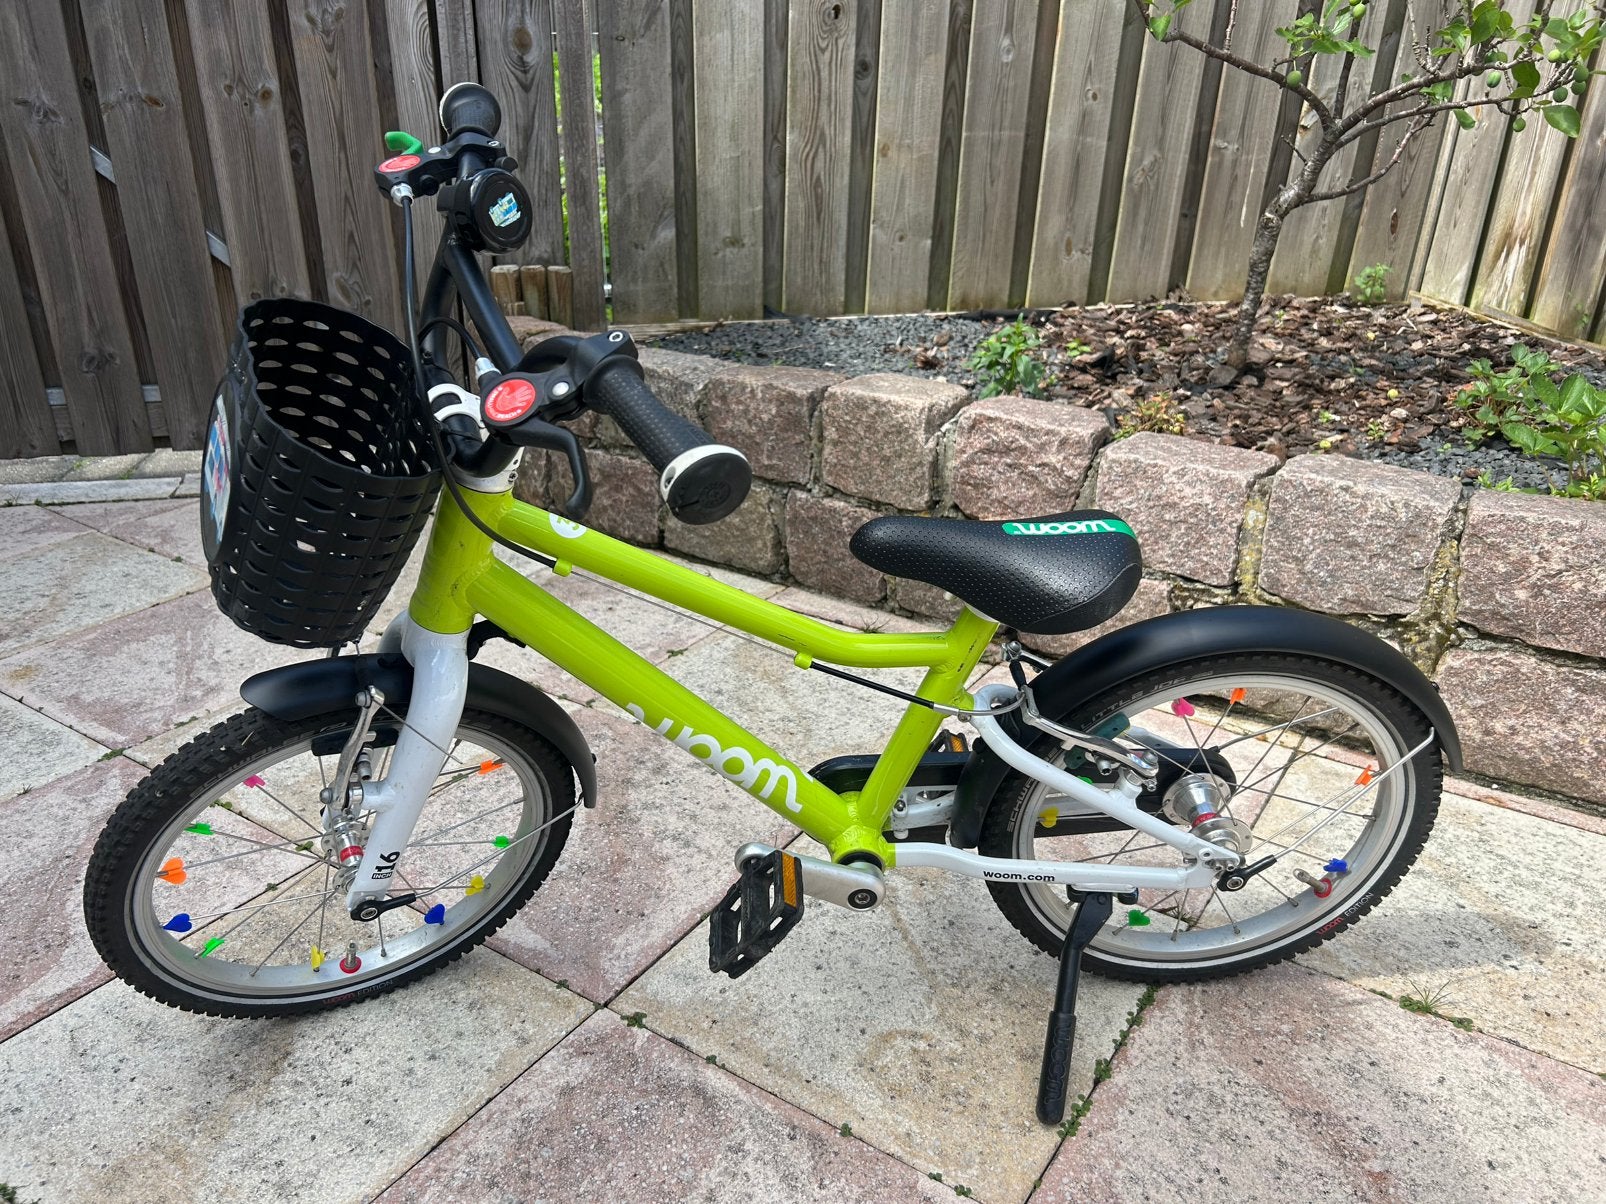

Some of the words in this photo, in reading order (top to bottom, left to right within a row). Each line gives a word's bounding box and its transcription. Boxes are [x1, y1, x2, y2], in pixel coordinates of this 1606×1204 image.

[1013, 520, 1116, 535] woom
[375, 851, 400, 872] 16
[371, 871, 393, 880] INCH
[983, 870, 1055, 882] woom.com
[1316, 917, 1344, 935] woom
[1344, 892, 1374, 917] EDITION
[357, 980, 394, 997] EDITION
